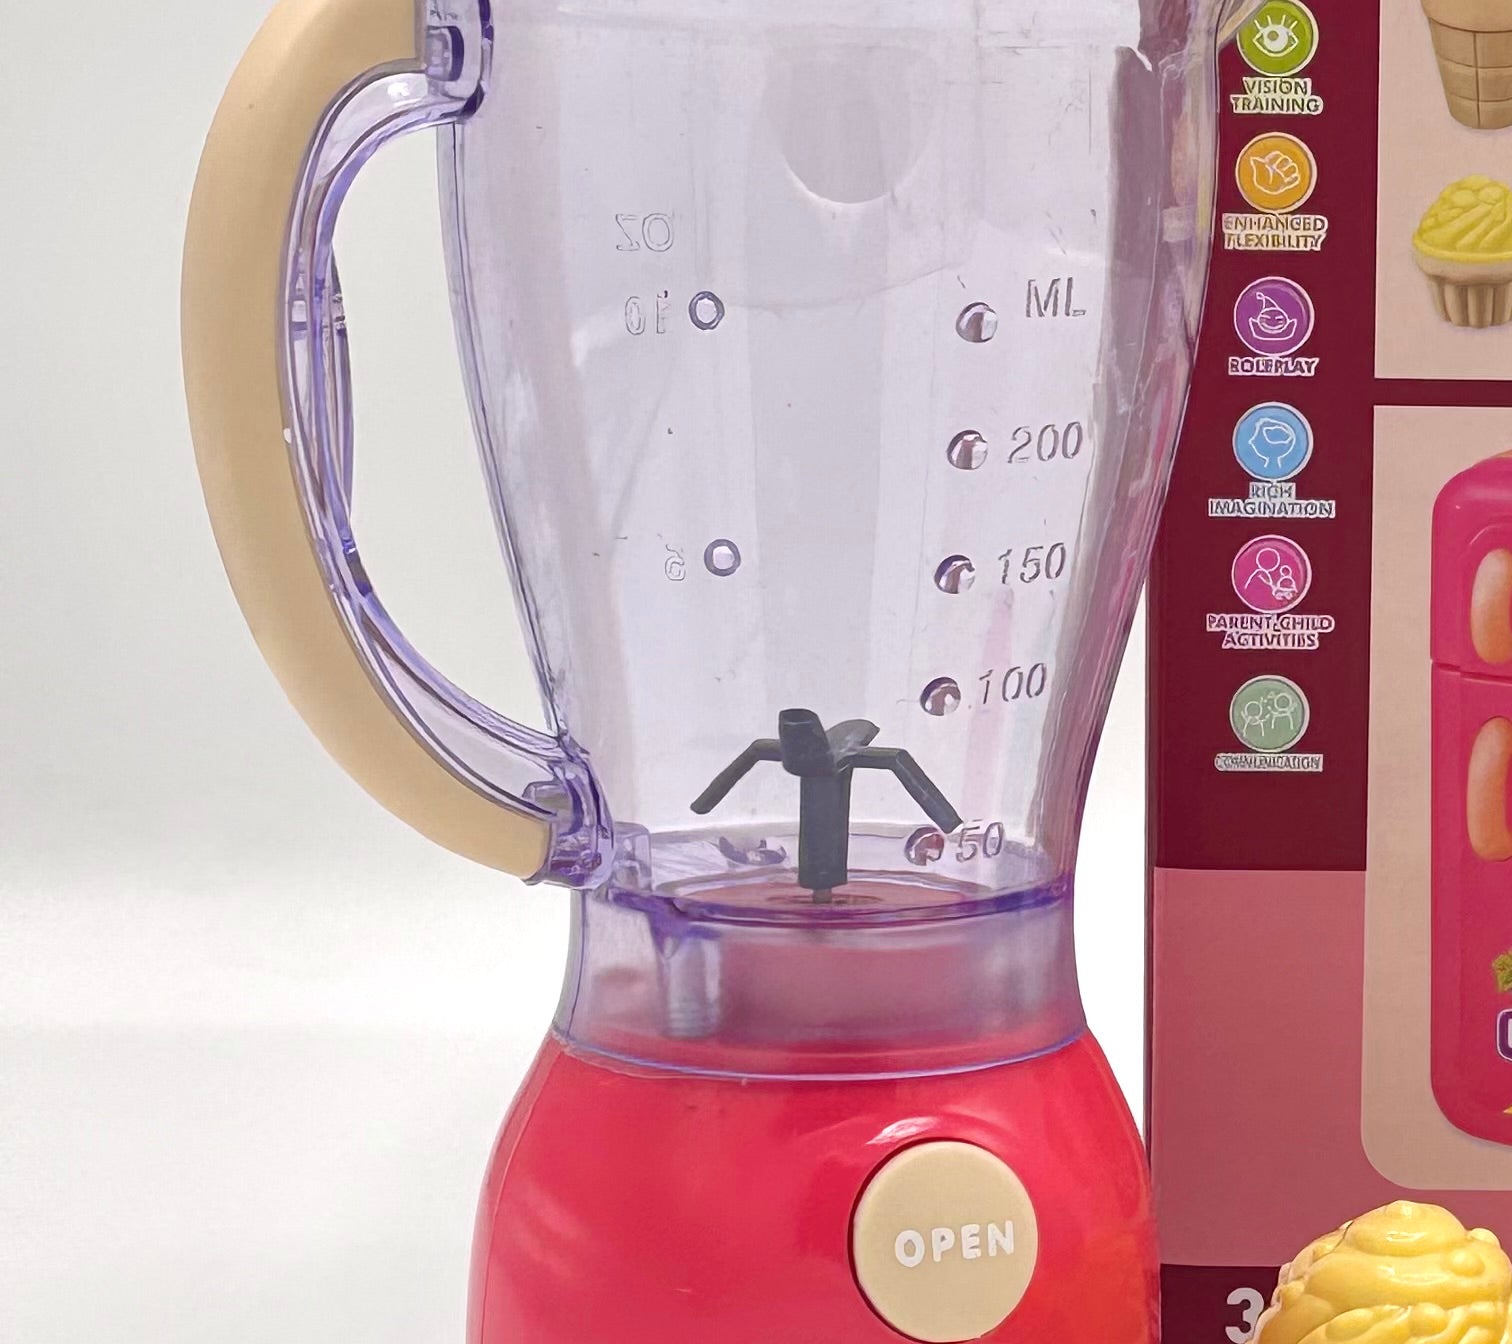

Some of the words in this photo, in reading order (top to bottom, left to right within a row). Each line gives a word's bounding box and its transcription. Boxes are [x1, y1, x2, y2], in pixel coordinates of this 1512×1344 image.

[1231, 96, 1320, 113] TRAINING
[1244, 79, 1308, 95] VISION
[1223, 216, 1326, 232] ENHANCED
[1025, 277, 1086, 318] ML
[1007, 421, 1084, 464] 200
[1210, 501, 1333, 517] IMAGINATION
[999, 542, 1067, 585] 150
[978, 662, 1047, 704] 100
[955, 820, 1004, 863] 50
[895, 1220, 1014, 1268] OPEN
